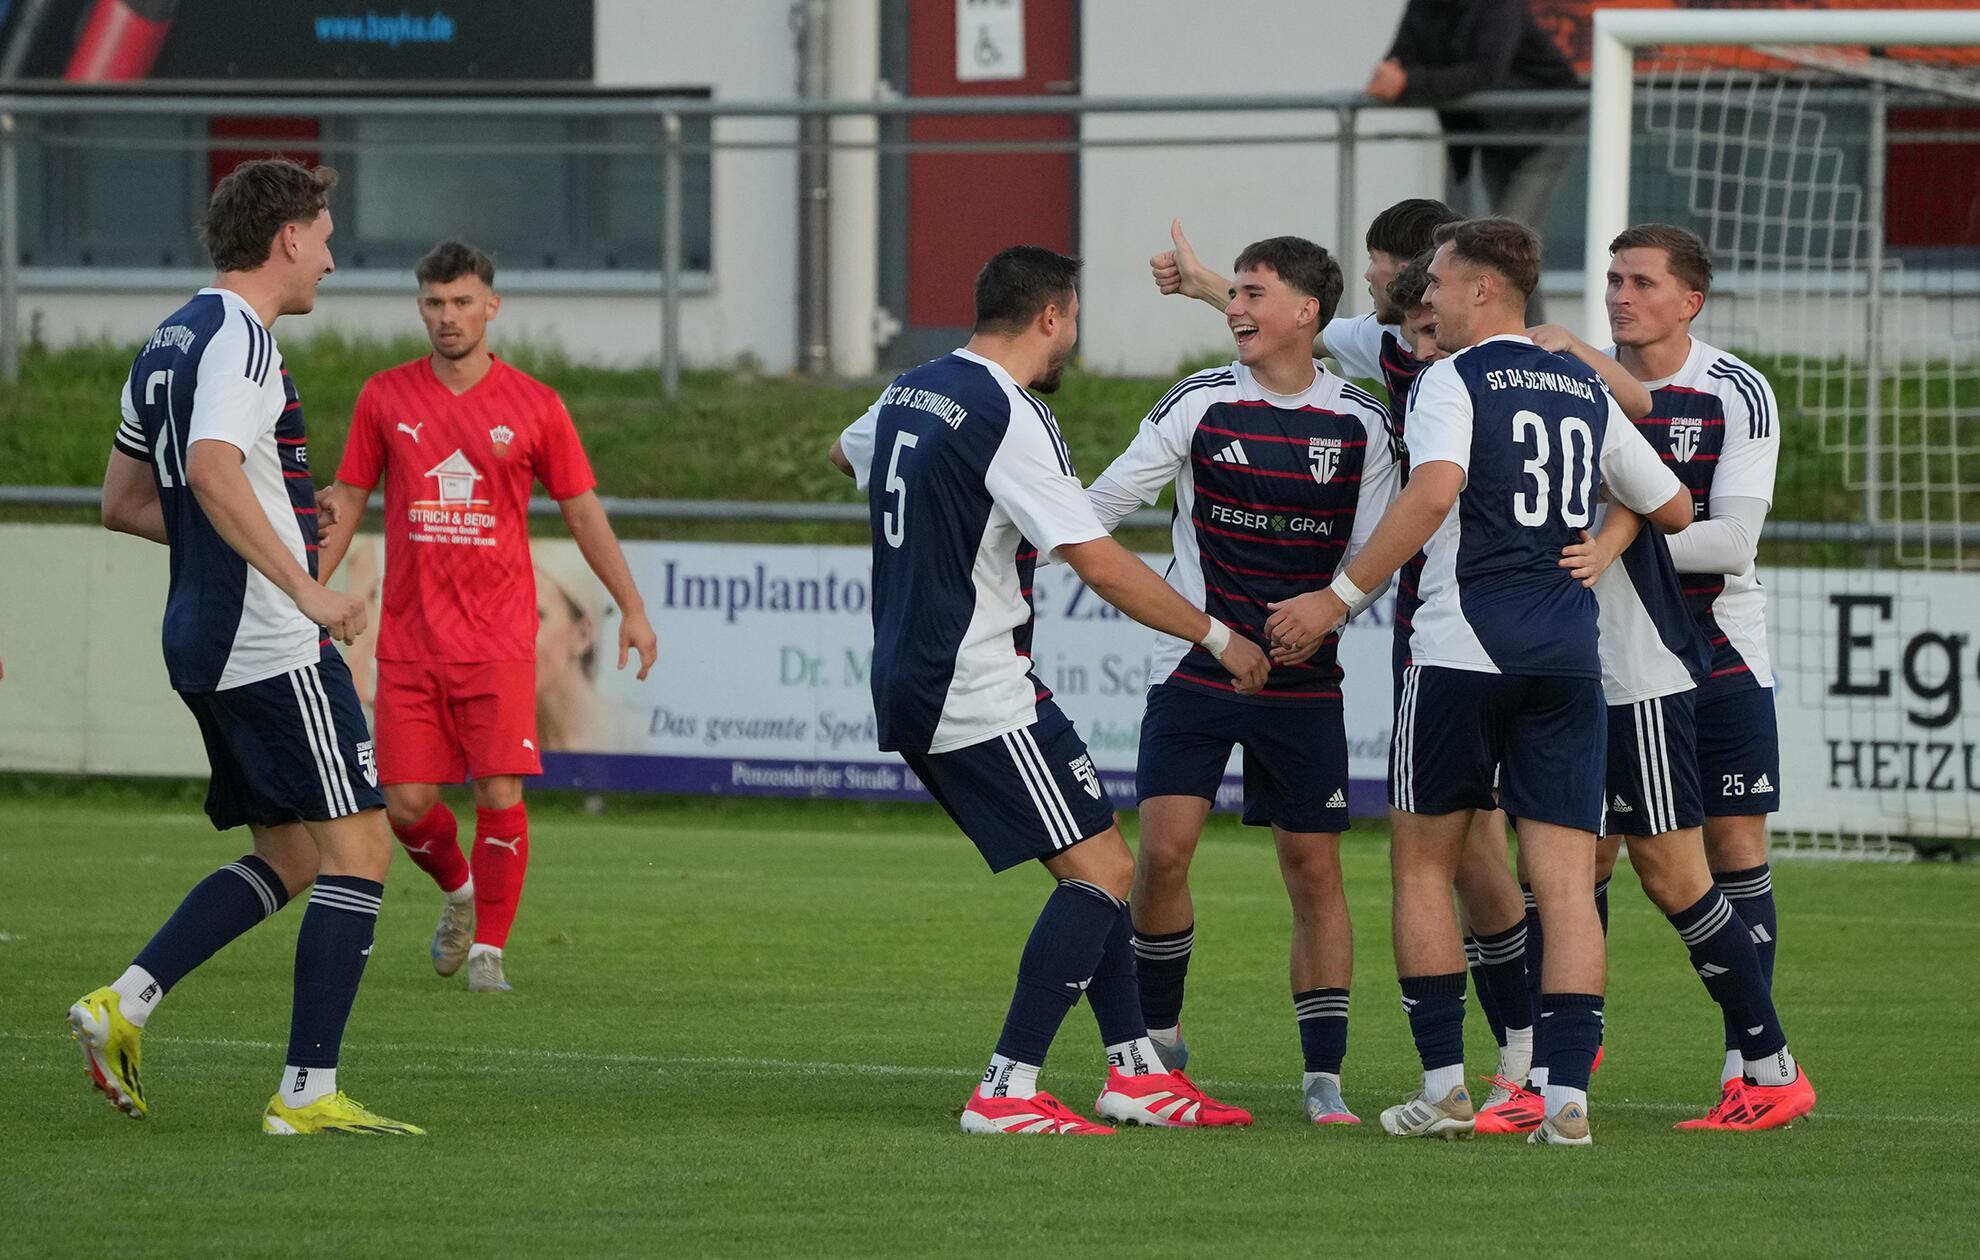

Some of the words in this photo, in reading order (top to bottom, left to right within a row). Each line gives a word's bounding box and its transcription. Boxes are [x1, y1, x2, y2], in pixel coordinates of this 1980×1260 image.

[1487, 370, 1507, 390] SC
[1506, 369, 1524, 388] 04
[1523, 370, 1596, 404] SCHWABACH
[897, 387, 916, 407] 04
[909, 389, 968, 430] SCHWABACH
[1309, 437, 1342, 447] SCHWABACH
[883, 430, 919, 549] 5
[1512, 410, 1594, 528] 30
[452, 511, 462, 526] &
[1210, 505, 1268, 530] FESER
[1289, 517, 1334, 536] GRA
[662, 559, 872, 625] Implanto
[780, 646, 830, 687] Dr.
[1055, 652, 1089, 695] in
[1829, 594, 1980, 729] Eg
[649, 707, 698, 738] Das
[703, 714, 808, 748] gesamte
[1722, 774, 1745, 796] 25
